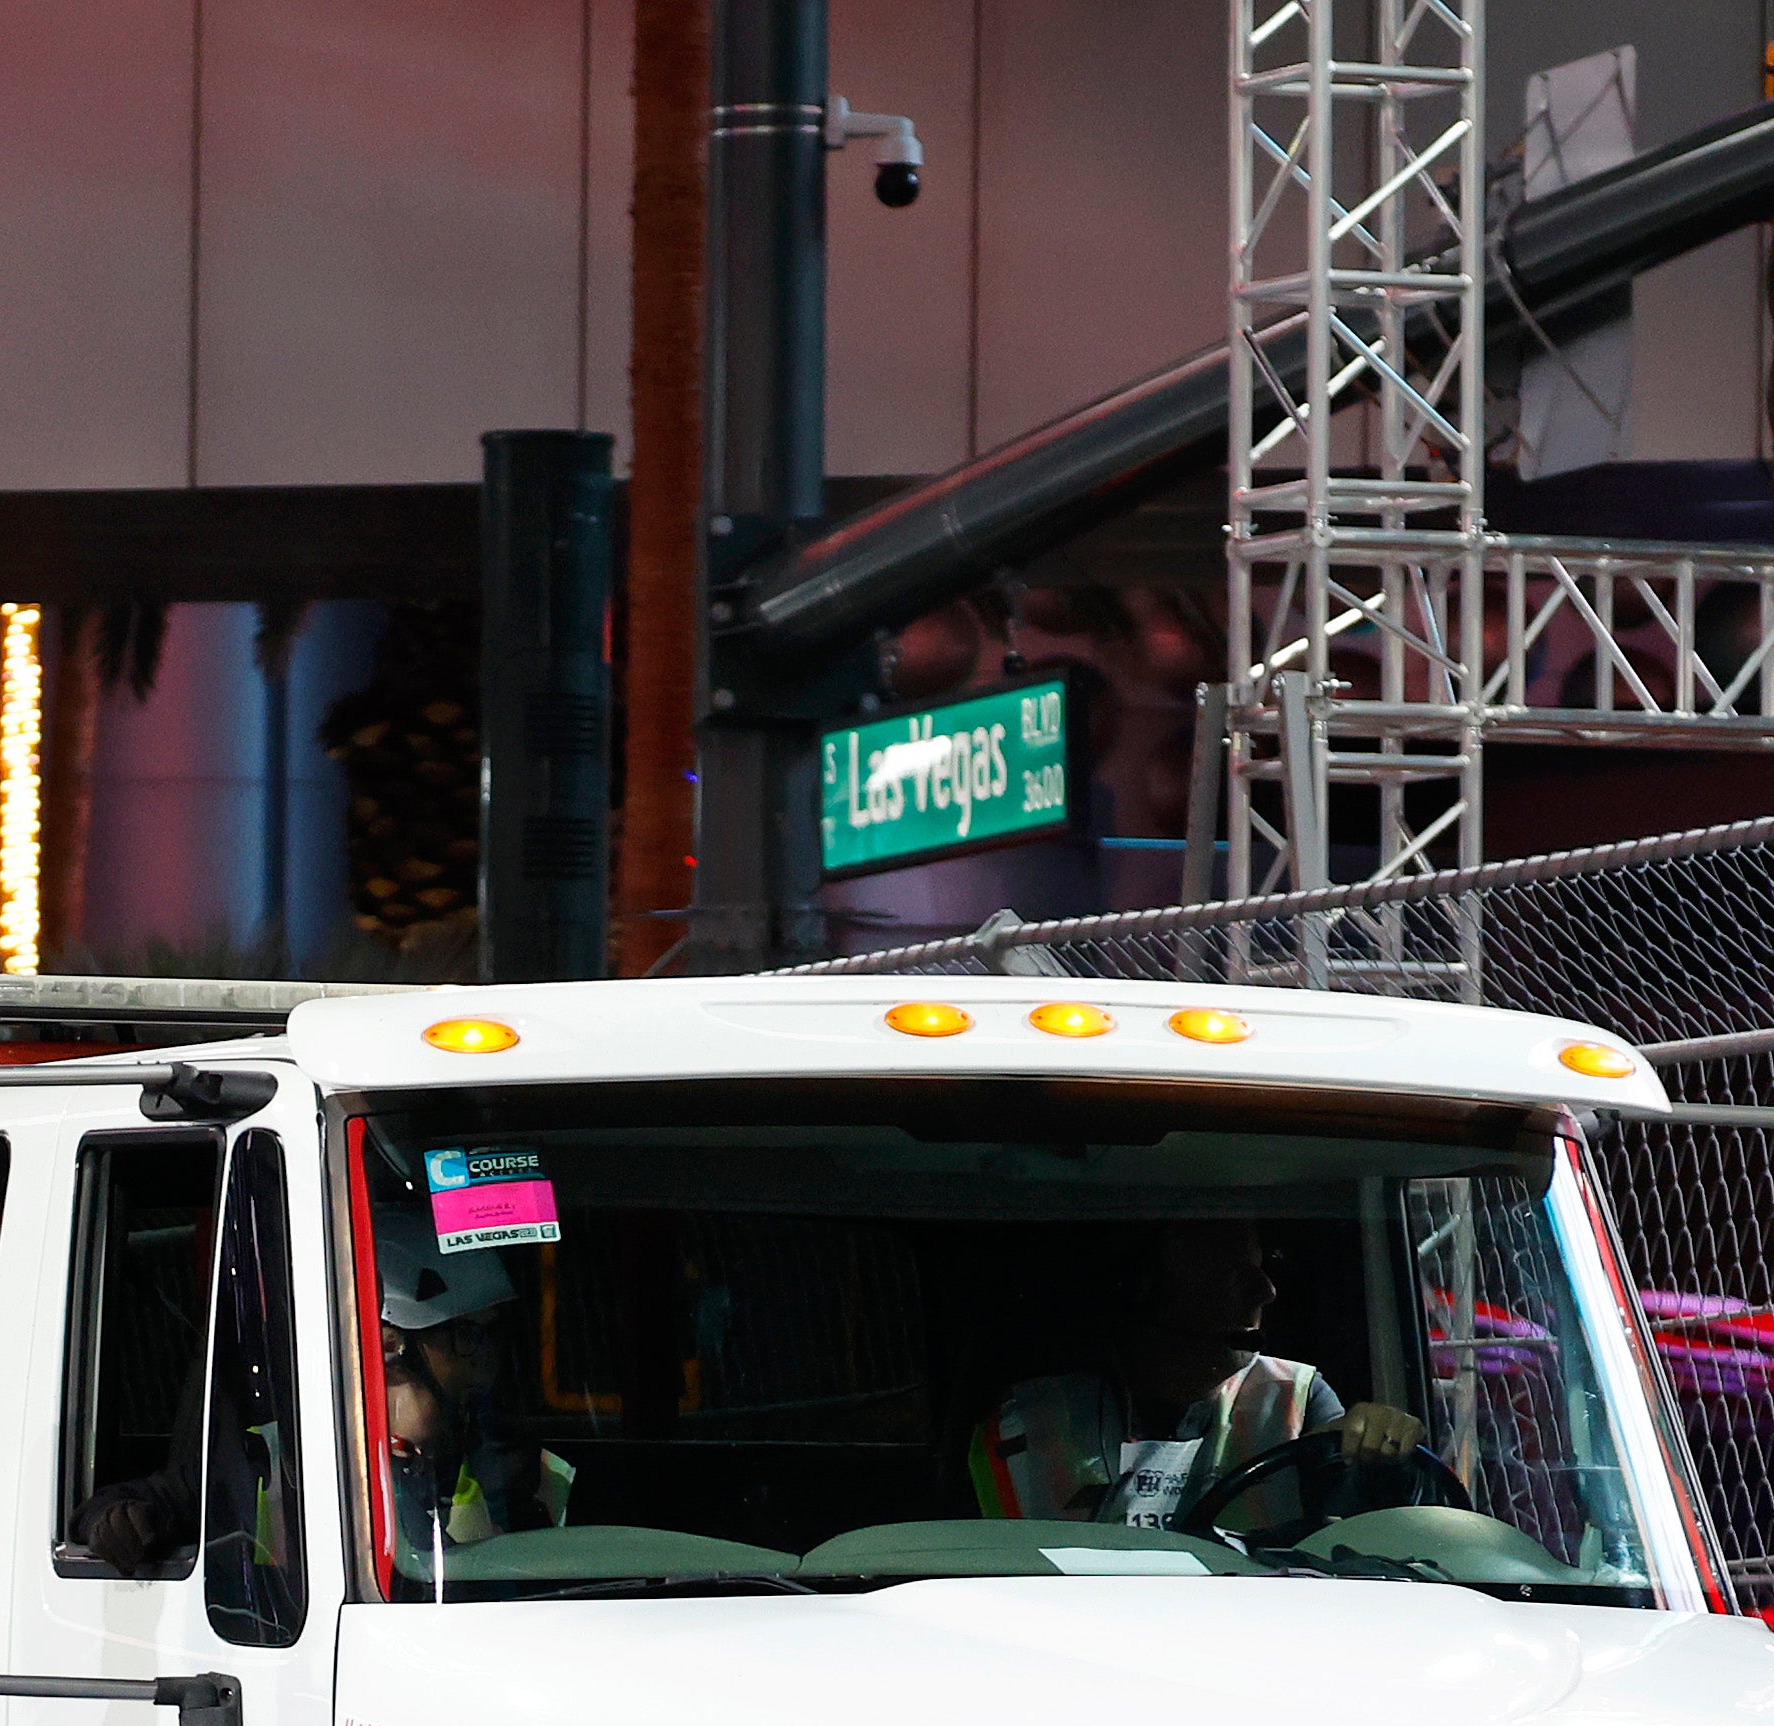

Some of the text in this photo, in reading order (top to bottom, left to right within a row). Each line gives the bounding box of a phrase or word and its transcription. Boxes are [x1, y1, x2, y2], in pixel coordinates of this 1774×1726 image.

[430, 1150, 540, 1186] C COURSE
[447, 1234, 473, 1247] LAS
[474, 1228, 519, 1242] VEGAS
